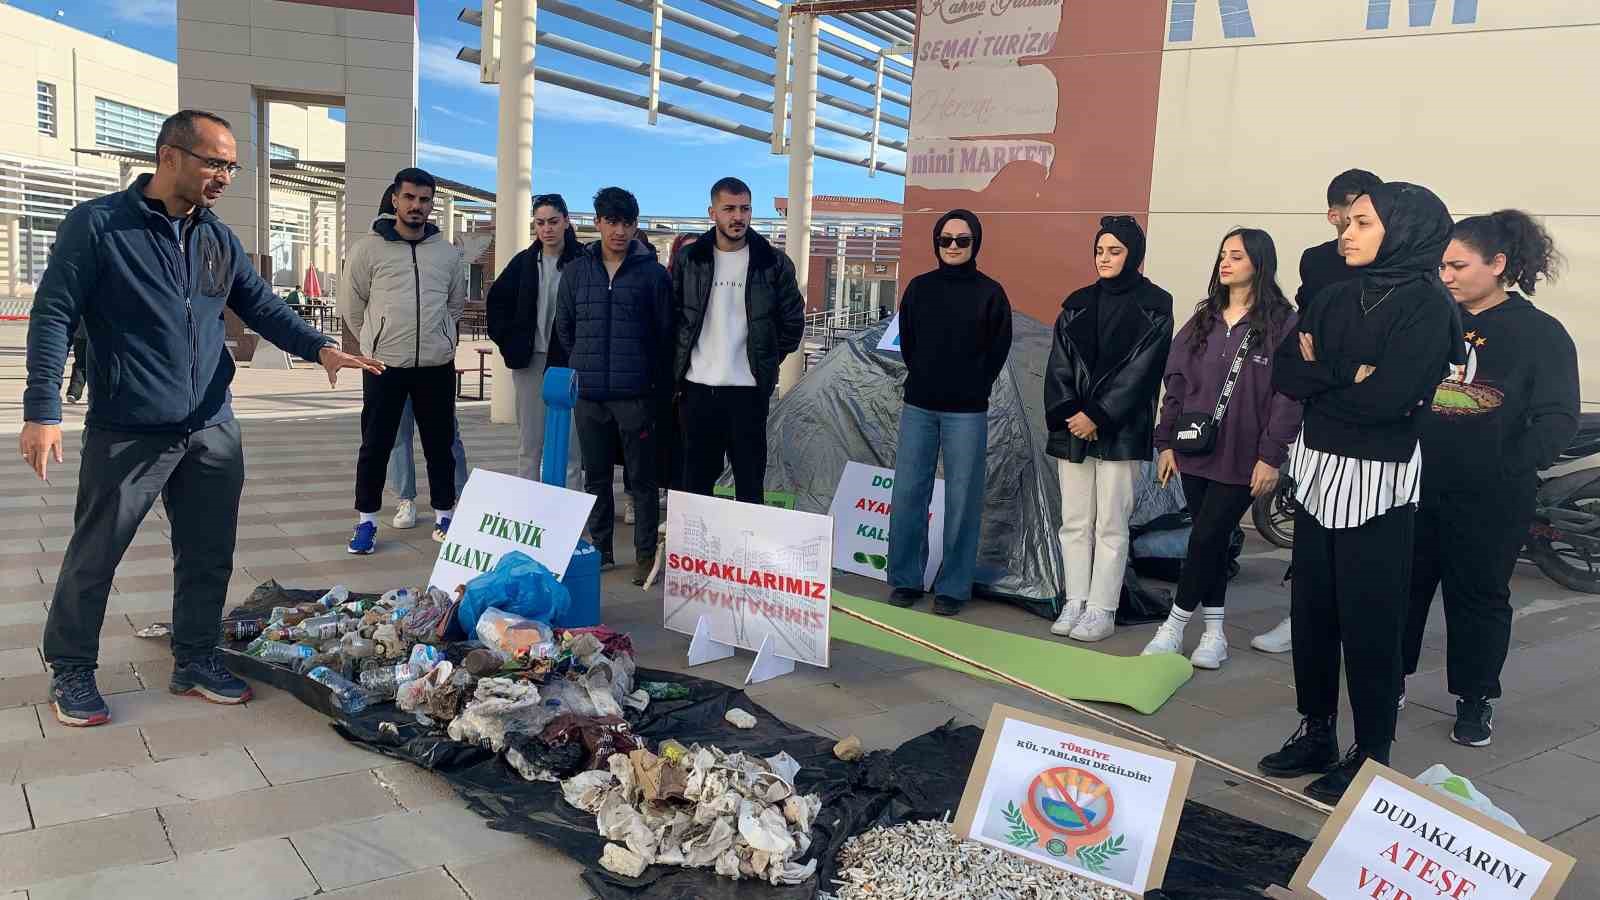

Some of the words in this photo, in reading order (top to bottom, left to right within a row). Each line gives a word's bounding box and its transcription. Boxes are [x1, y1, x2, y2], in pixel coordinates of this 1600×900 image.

[983, 27, 1057, 57] TURİZM
[911, 148, 954, 174] mini
[1177, 430, 1198, 440] PUMA
[871, 475, 894, 489] DO
[478, 511, 546, 549] PİKNİK
[668, 553, 826, 600] SOKAKLARIMIZ
[1016, 739, 1039, 752] KÜL
[1041, 746, 1091, 766] TABLASI
[1093, 760, 1152, 783] DEĞİLDİR!
[1060, 742, 1111, 761] TÜRKİYE
[1372, 797, 1527, 890] DUDAKLARINI
